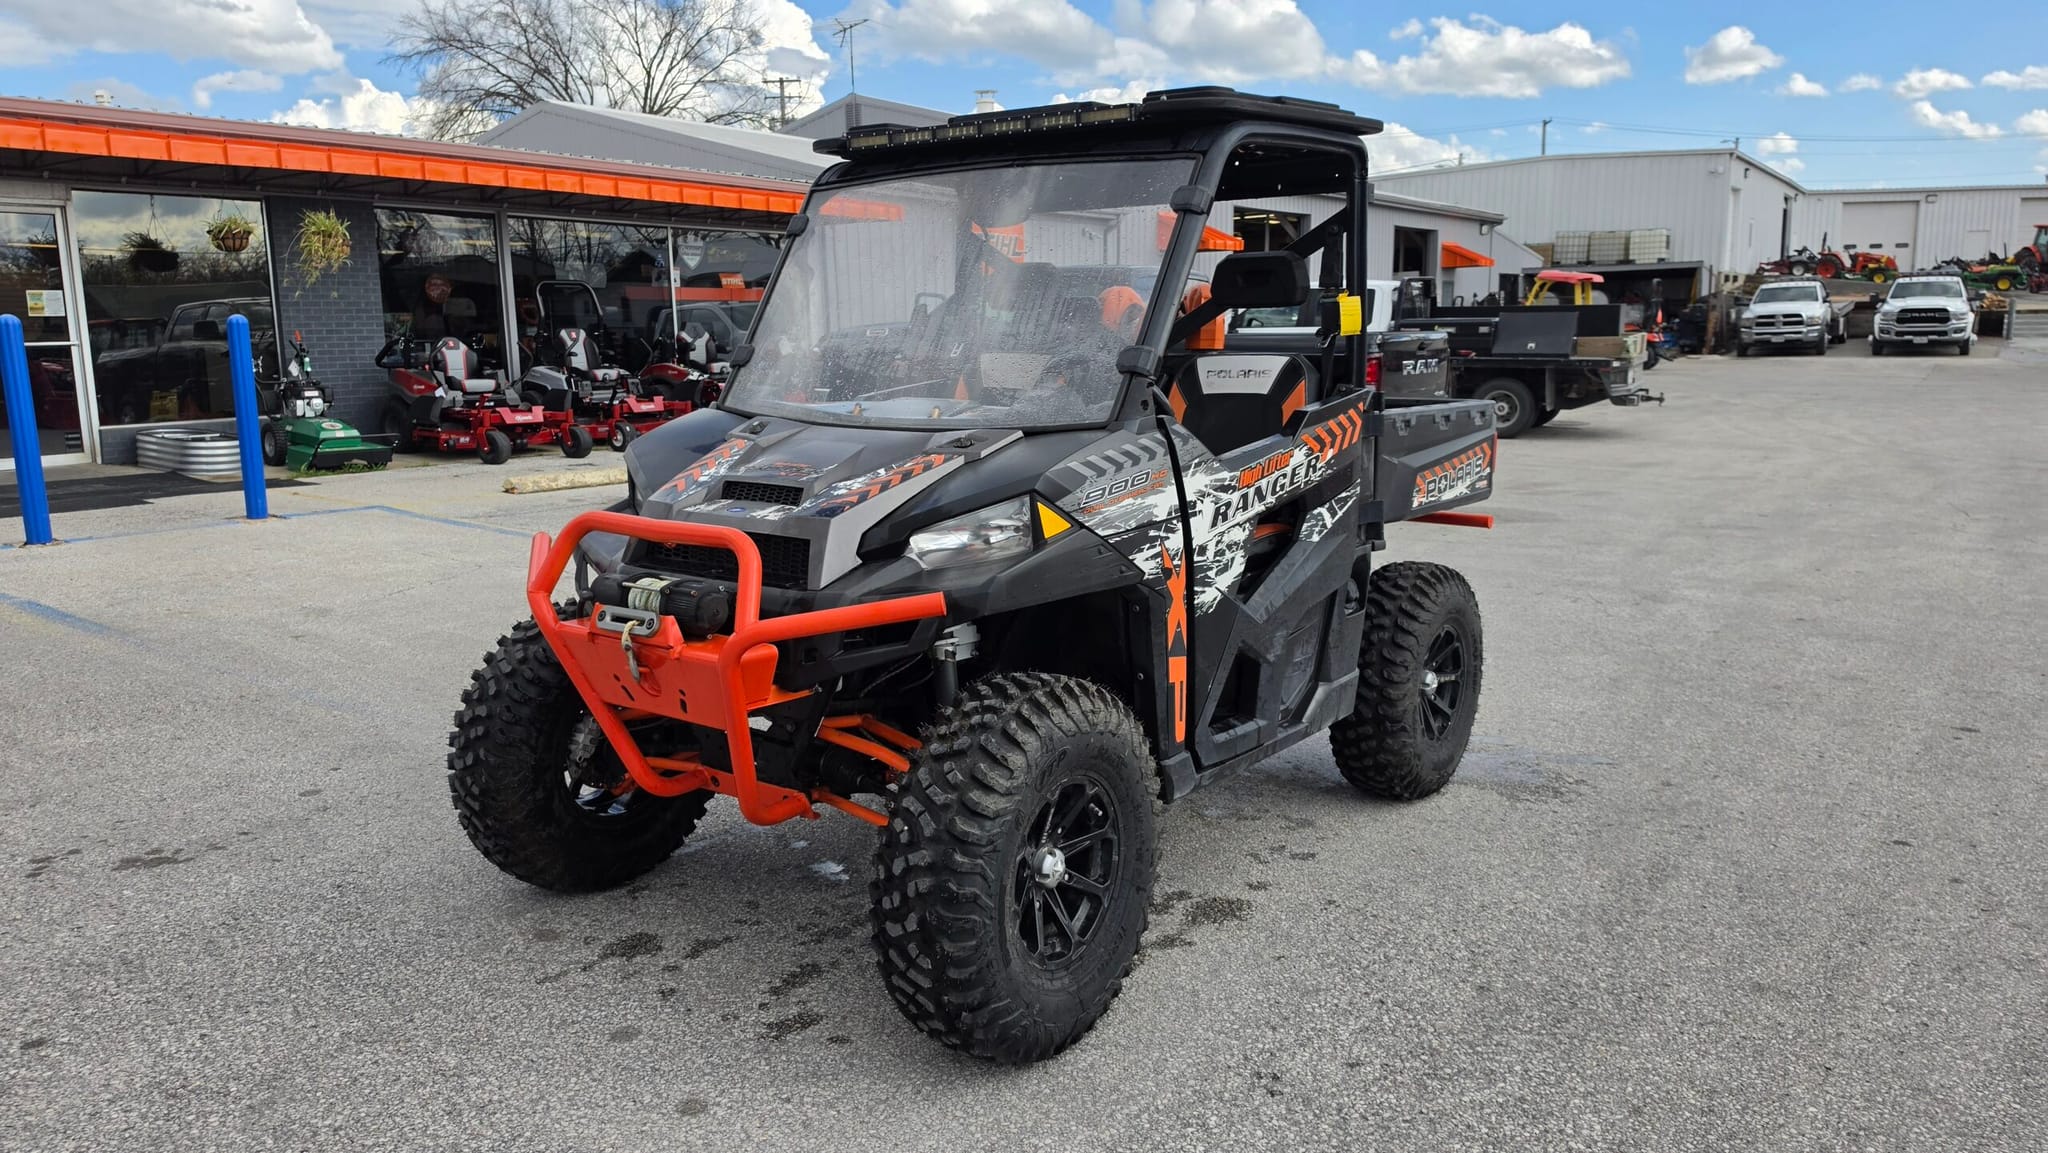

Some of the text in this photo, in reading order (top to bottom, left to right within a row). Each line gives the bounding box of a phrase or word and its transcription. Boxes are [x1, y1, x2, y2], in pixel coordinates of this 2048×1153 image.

[1206, 368, 1273, 379] POLARIS
[1402, 358, 1439, 376] RAM
[1080, 469, 1152, 508] 900
[1239, 449, 1295, 490] High Lifter
[1425, 454, 1484, 501] POLARIS
[1209, 452, 1322, 530] RANGER
